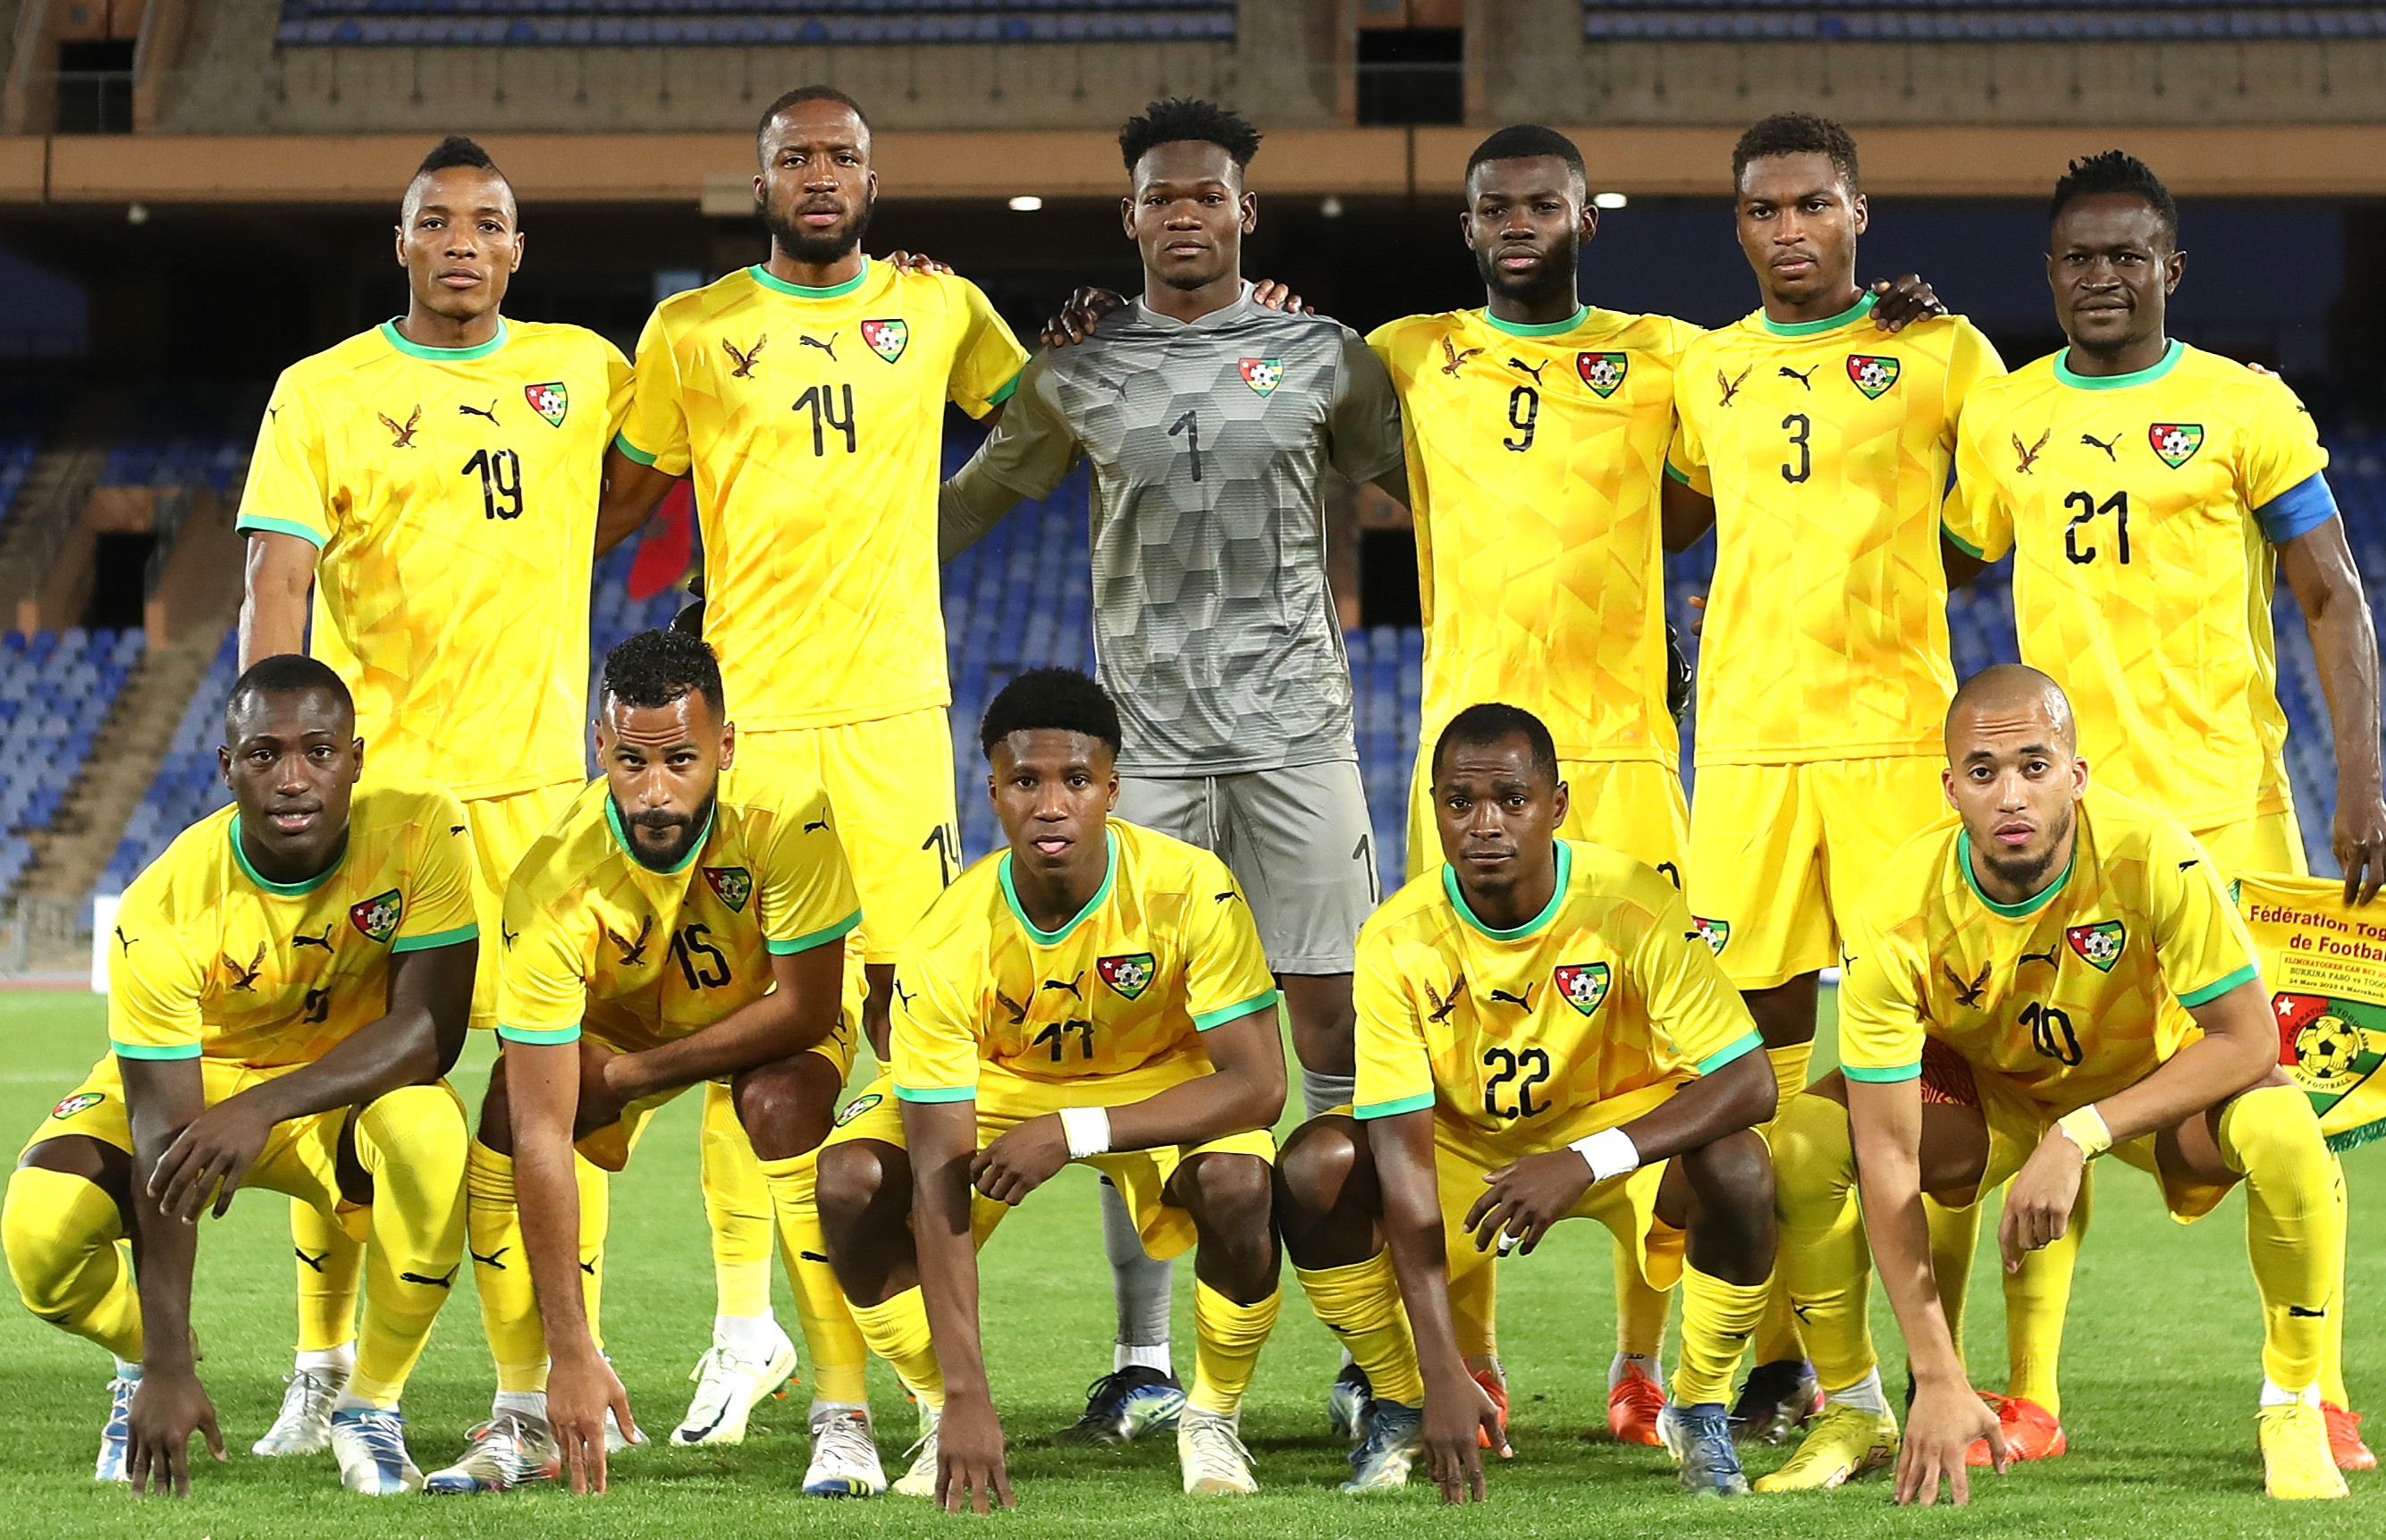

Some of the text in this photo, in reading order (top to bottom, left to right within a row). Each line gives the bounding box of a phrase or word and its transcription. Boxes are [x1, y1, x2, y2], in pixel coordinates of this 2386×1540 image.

[791, 383, 856, 457] 14
[1168, 410, 1203, 483] 1
[1503, 384, 1539, 452] 9
[1782, 413, 1811, 484] 3
[461, 449, 523, 520] 19
[2064, 491, 2130, 565] 21
[2250, 905, 2348, 932] Fédération
[2289, 933, 2312, 950] de
[664, 921, 732, 991] 15
[2290, 967, 2325, 979] BURKINA
[1032, 1020, 1095, 1062] 17
[2018, 1001, 2084, 1067] 10
[1483, 1048, 1552, 1121] 22
